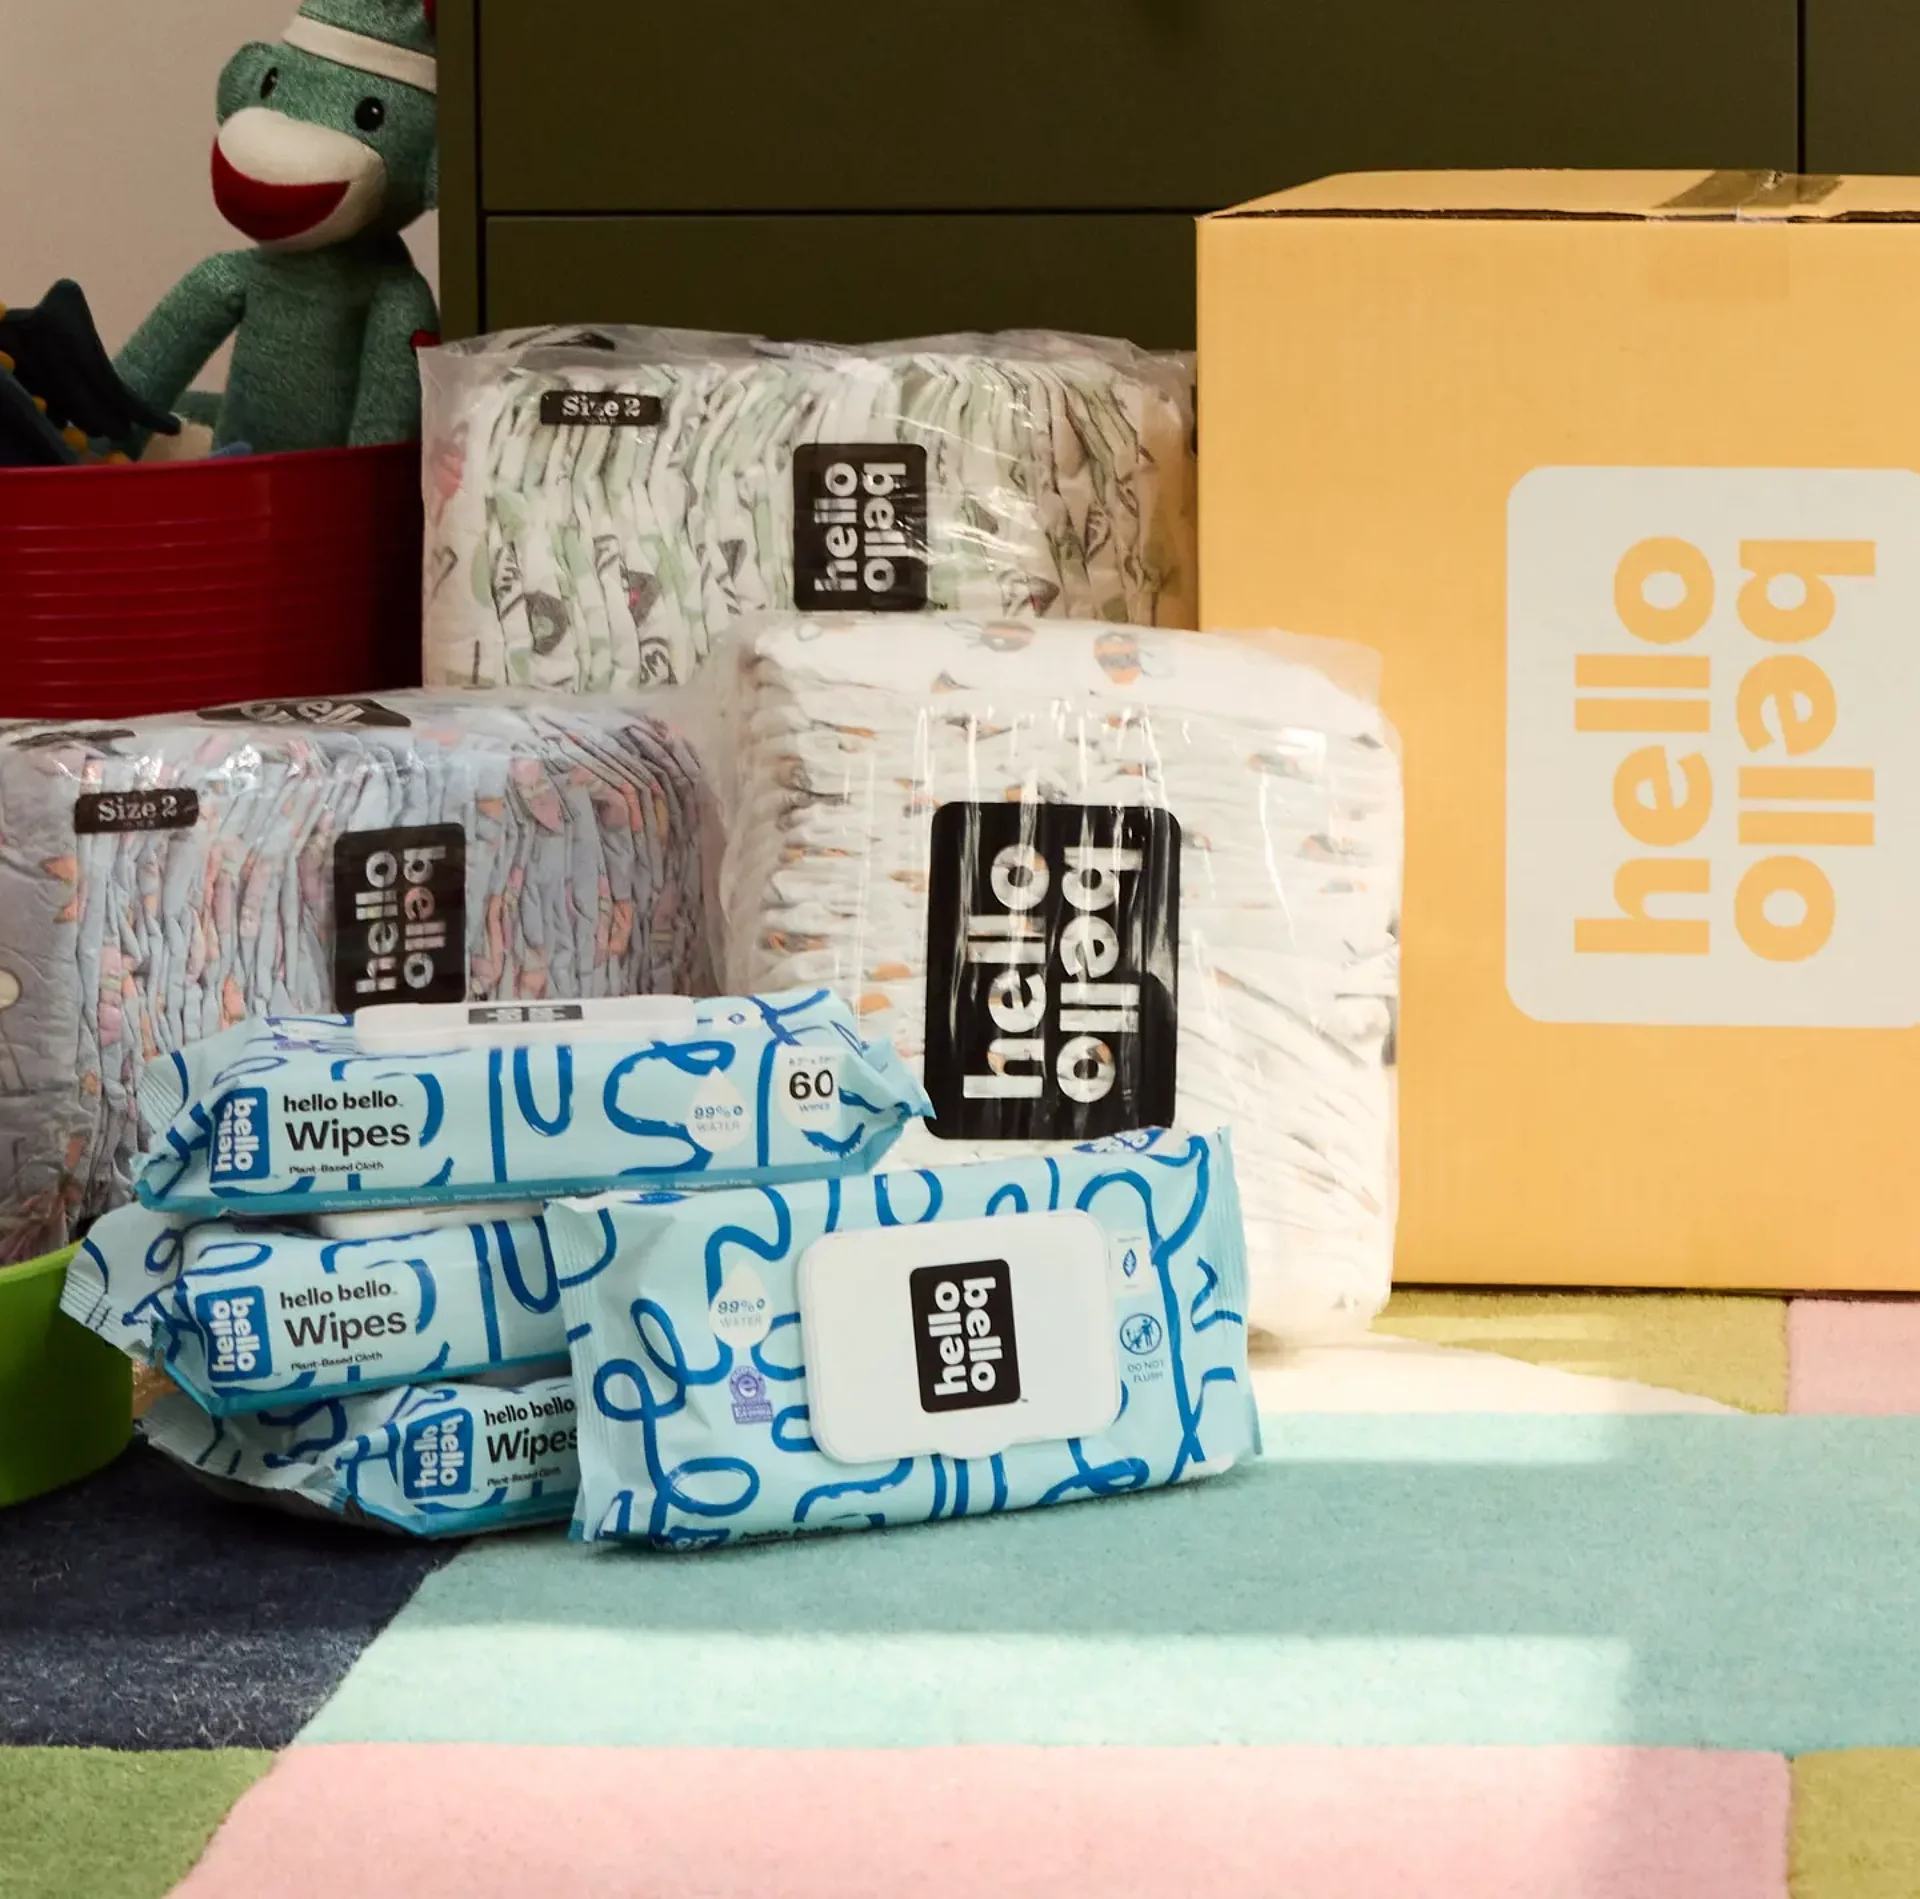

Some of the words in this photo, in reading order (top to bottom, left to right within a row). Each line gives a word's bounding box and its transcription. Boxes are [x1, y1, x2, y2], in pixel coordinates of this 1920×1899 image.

[624, 397, 641, 417] 2
[814, 463, 858, 591] hello
[863, 463, 907, 592] bello
[1574, 536, 1715, 955] hello
[1734, 540, 1876, 962] bello
[97, 797, 157, 821] Size
[161, 795, 178, 818] 2
[355, 851, 398, 993] hello
[403, 847, 446, 989] bello
[962, 844, 1050, 1099] hello
[1056, 847, 1143, 1103] bello
[283, 1093, 338, 1113] hello
[789, 1070, 834, 1100] 60
[214, 1101, 234, 1173] hello
[234, 1097, 259, 1172] bello
[285, 1118, 411, 1156] Wipes
[355, 1160, 384, 1171] Cloth
[231, 1296, 261, 1372] bello
[280, 1287, 334, 1310] hello
[284, 1310, 408, 1349] Wipes
[962, 1276, 1003, 1392] bello
[209, 1299, 236, 1373] hello
[354, 1350, 383, 1363] Cloth
[928, 1281, 968, 1396] hello
[440, 1413, 465, 1488] bello
[483, 1405, 528, 1427] hello
[486, 1427, 578, 1466] Wipes
[413, 1424, 439, 1489] hello
